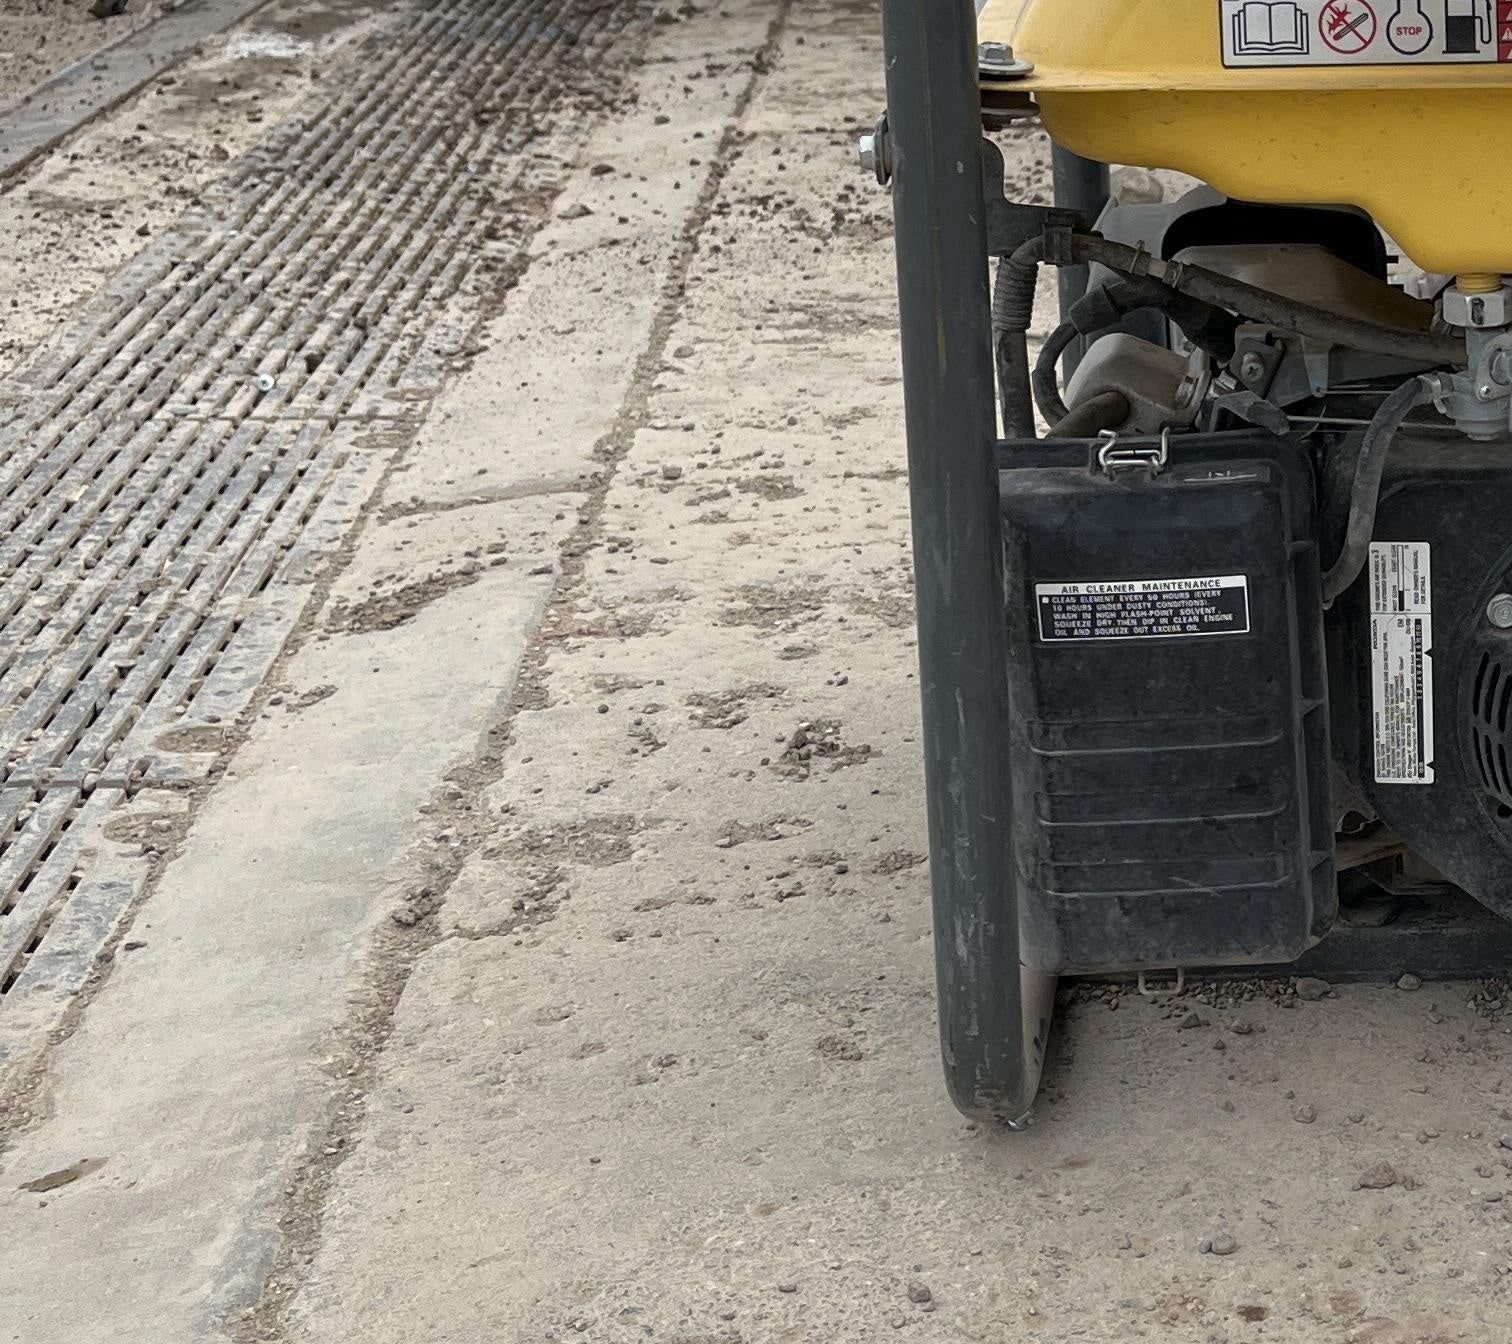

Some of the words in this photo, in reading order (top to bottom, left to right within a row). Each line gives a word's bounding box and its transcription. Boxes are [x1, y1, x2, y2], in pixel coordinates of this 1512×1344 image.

[1396, 25, 1422, 37] STOP
[1061, 586, 1079, 594] AIR
[1086, 583, 1135, 593] CLEANER
[1142, 579, 1221, 591] MAINTENANCE
[1080, 595, 1115, 603] ELEMENT
[1119, 594, 1144, 602] EVERY
[1163, 592, 1190, 600] HOURS
[1066, 604, 1093, 612] HOURS
[1097, 603, 1123, 611] UNDER
[1127, 602, 1151, 610] DUSTY
[1096, 611, 1116, 619] HIGH
[1054, 620, 1092, 628] SQUEEZE
[1173, 616, 1199, 624] CLEAN
[1073, 628, 1090, 636] AND
[1094, 627, 1129, 635] SQUEEZE
[1133, 626, 1149, 634] OUT
